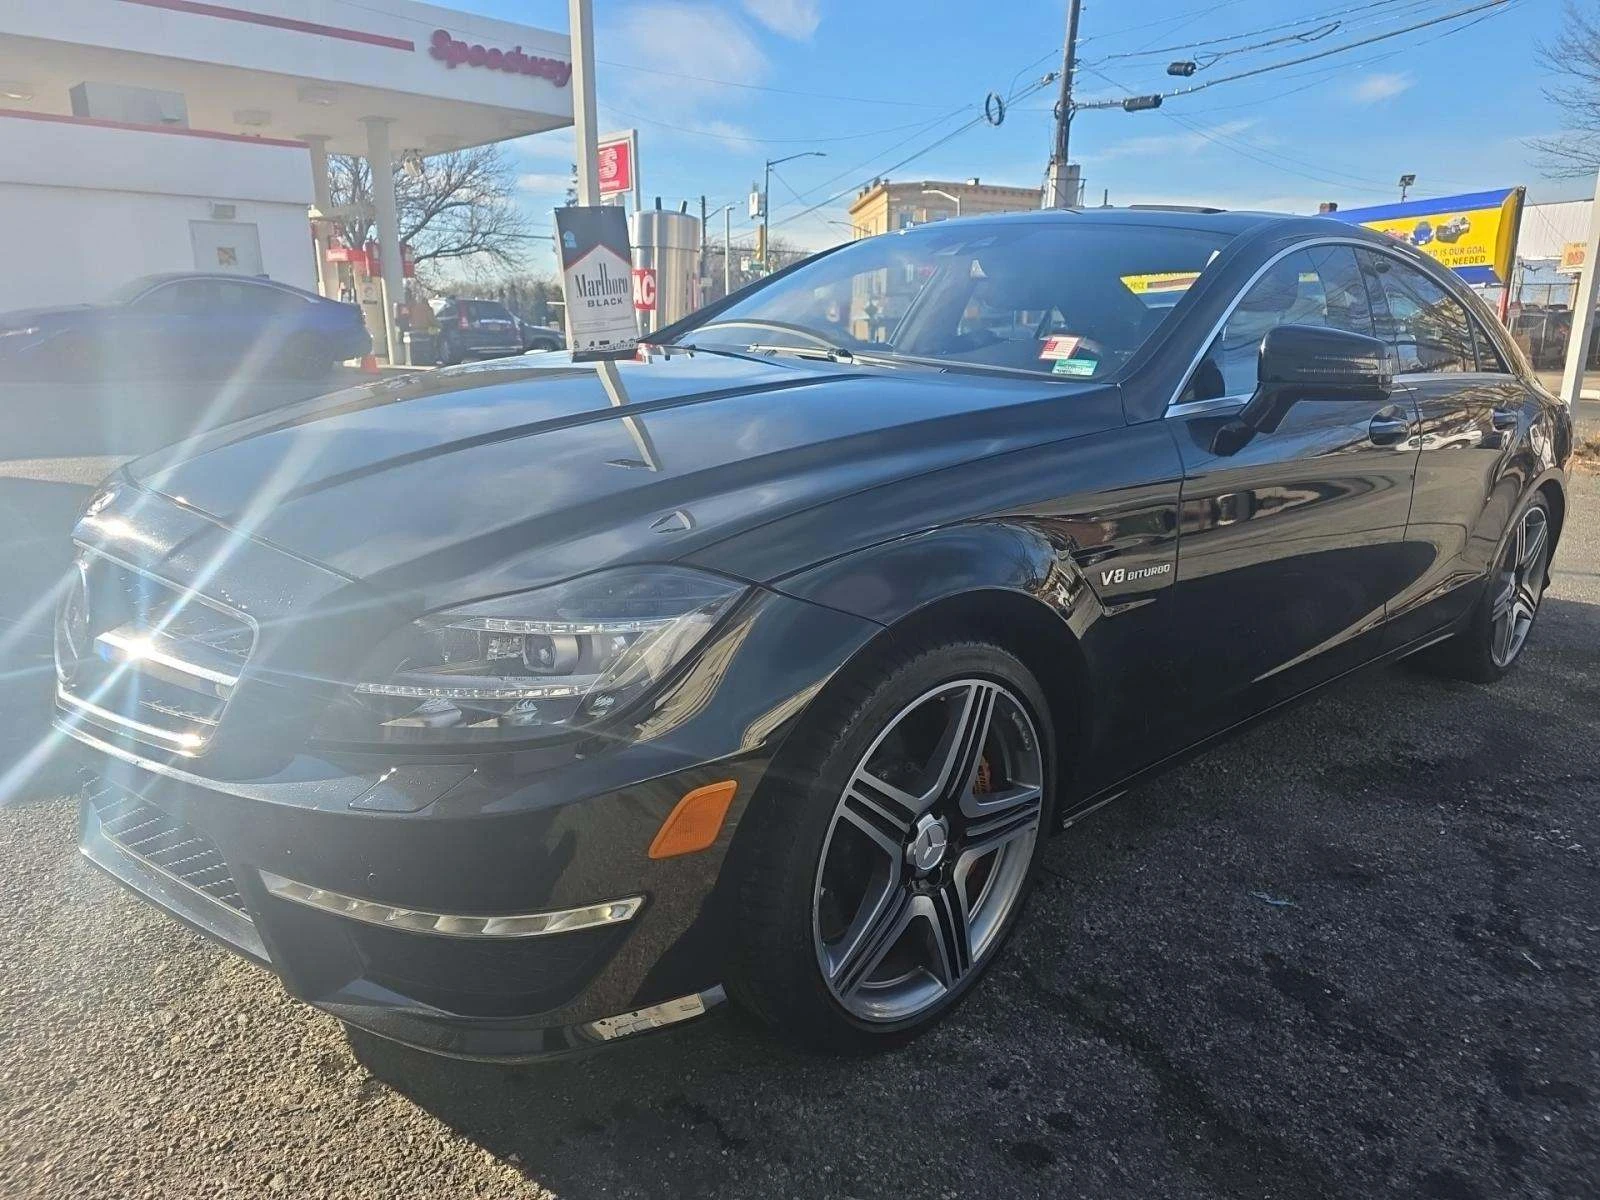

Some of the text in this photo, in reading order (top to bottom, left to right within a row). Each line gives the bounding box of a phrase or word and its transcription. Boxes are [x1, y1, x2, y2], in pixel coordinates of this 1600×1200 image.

[429, 29, 572, 87] Speedway
[1467, 245, 1486, 254] GOAL
[1453, 256, 1485, 265] NEEDED
[575, 263, 627, 298] Marlboro
[587, 298, 623, 307] BLACK
[1101, 564, 1170, 586] V8 BITURBO
